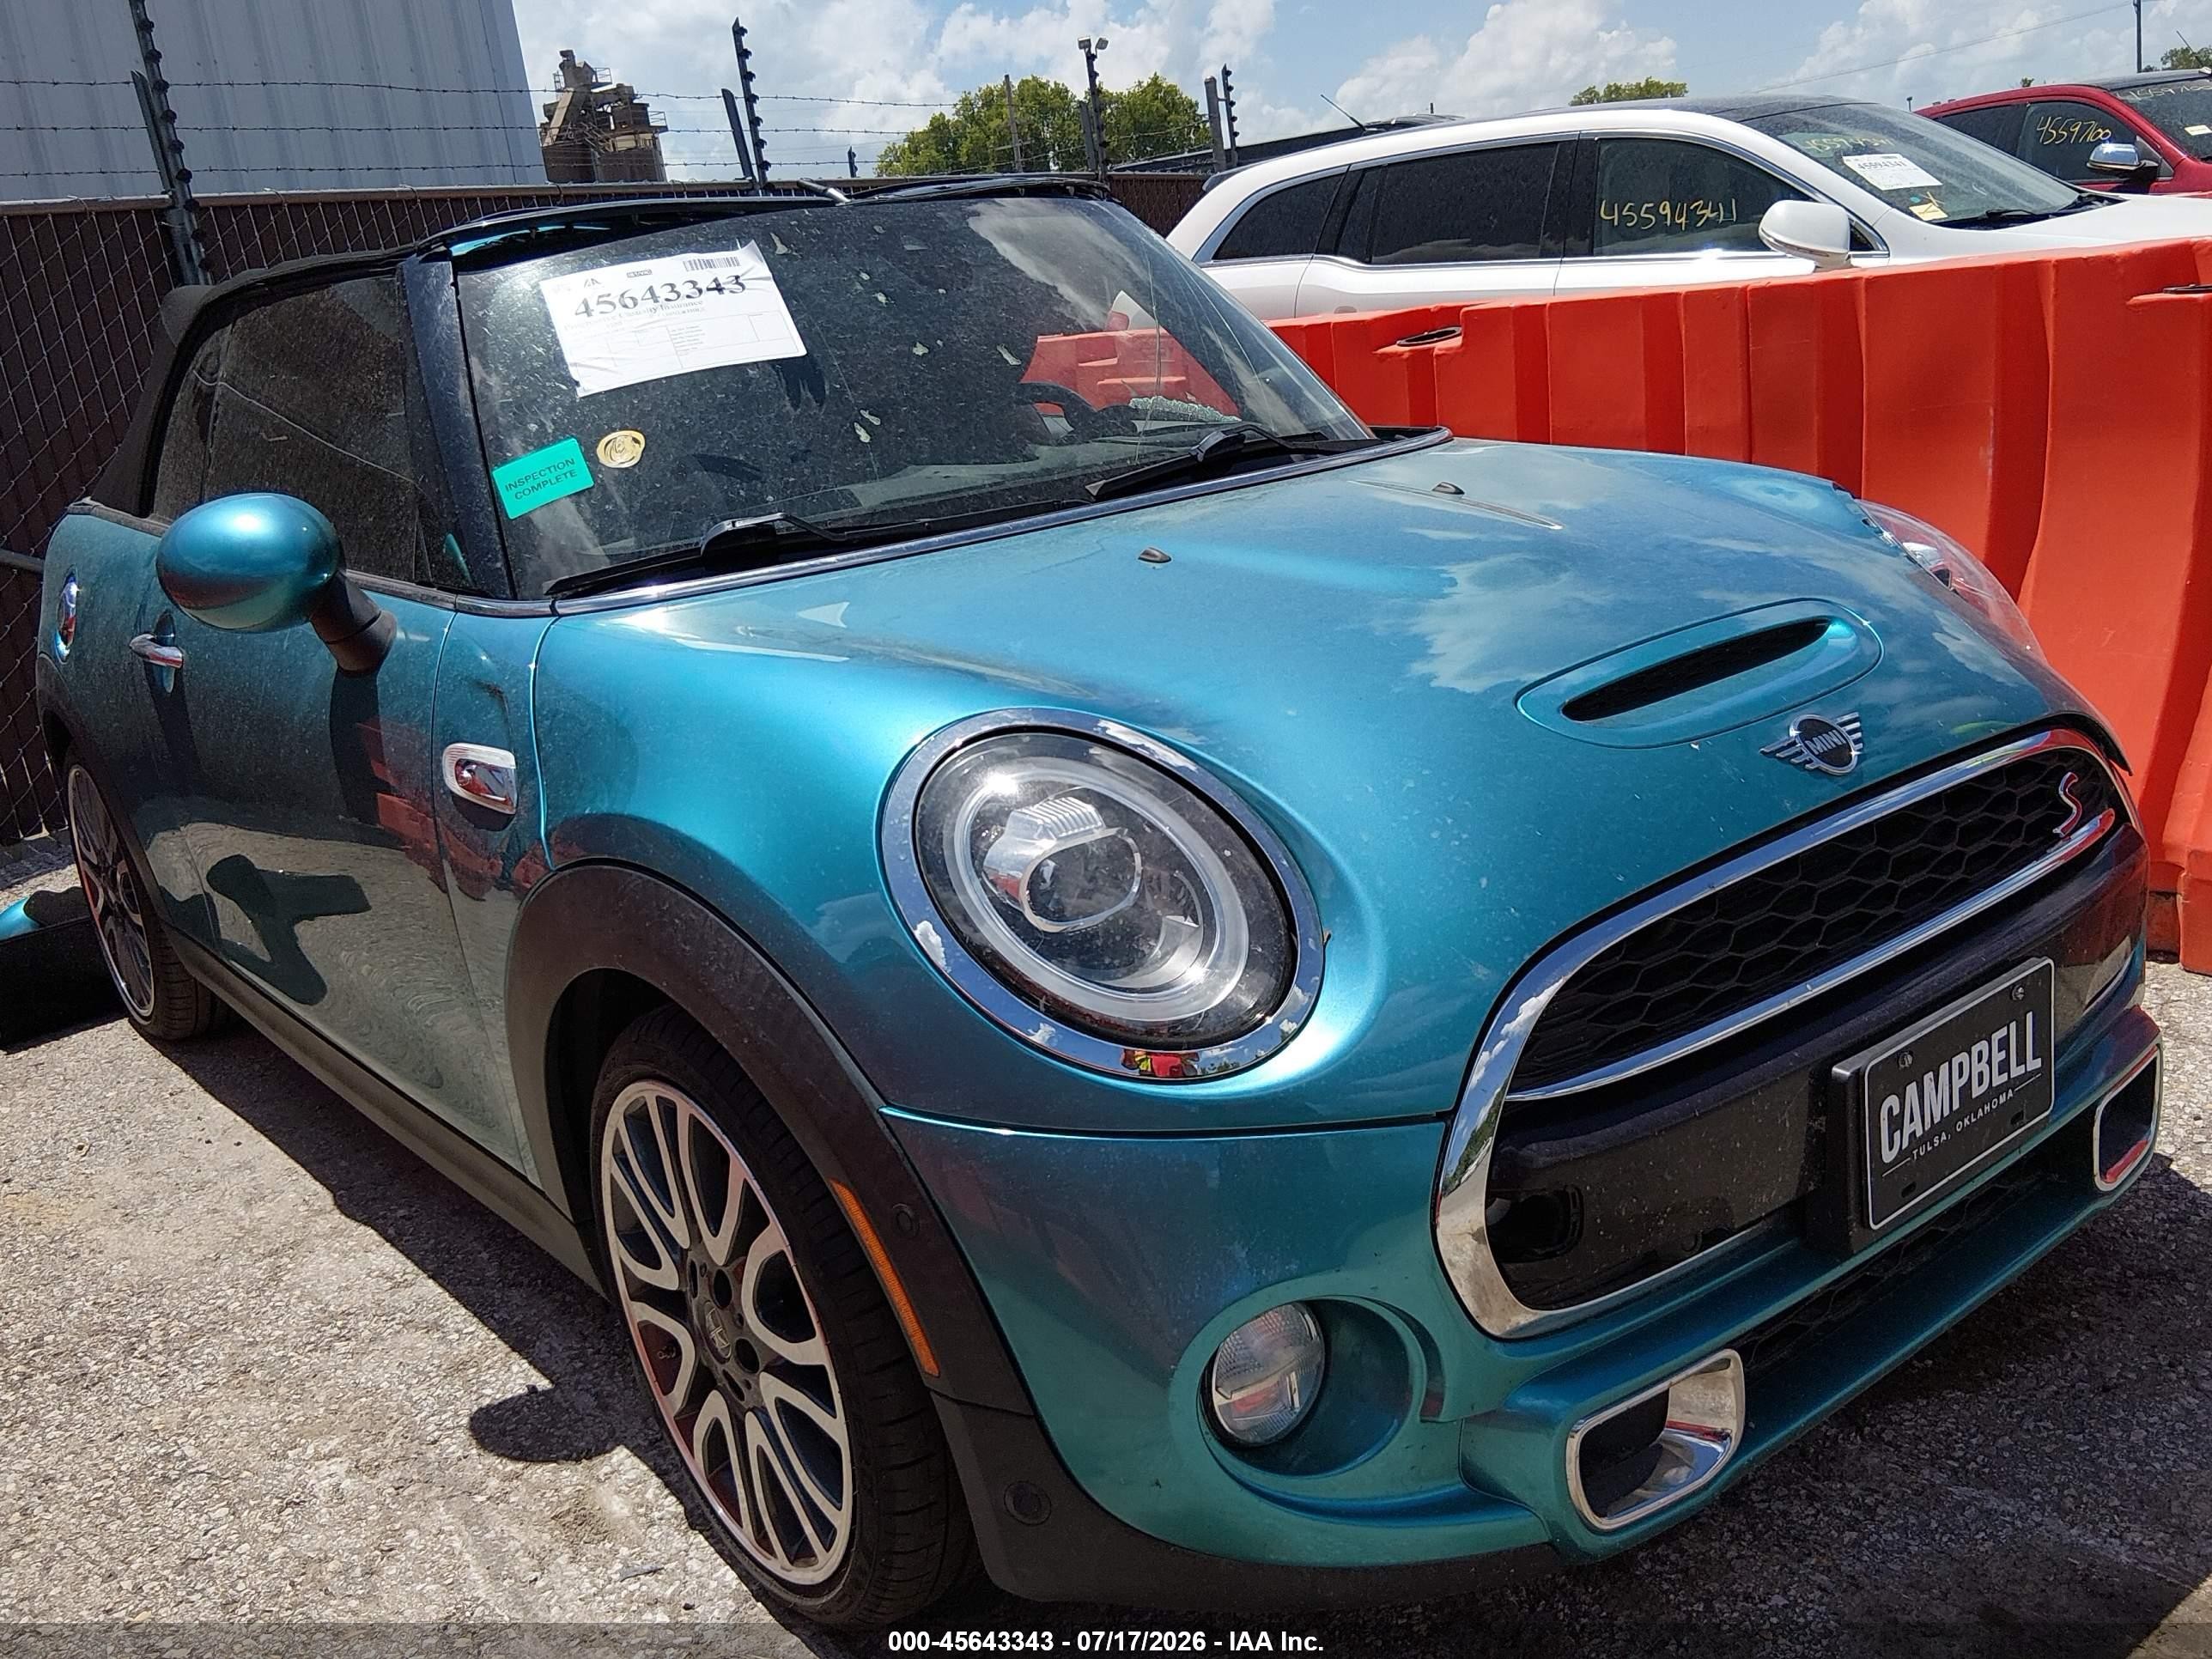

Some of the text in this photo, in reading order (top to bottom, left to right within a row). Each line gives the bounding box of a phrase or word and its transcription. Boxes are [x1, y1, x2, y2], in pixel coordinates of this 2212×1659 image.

[1600, 198, 1737, 231] 45594341
[574, 274, 746, 318] 45643343
[505, 458, 575, 493] INSPECTION
[514, 469, 578, 501] COMPLETE
[1804, 729, 1847, 755] MINI
[1880, 1011, 2042, 1164] CAMPBELL
[1911, 1088, 2014, 1161] TULSA, OKLAHOMA
